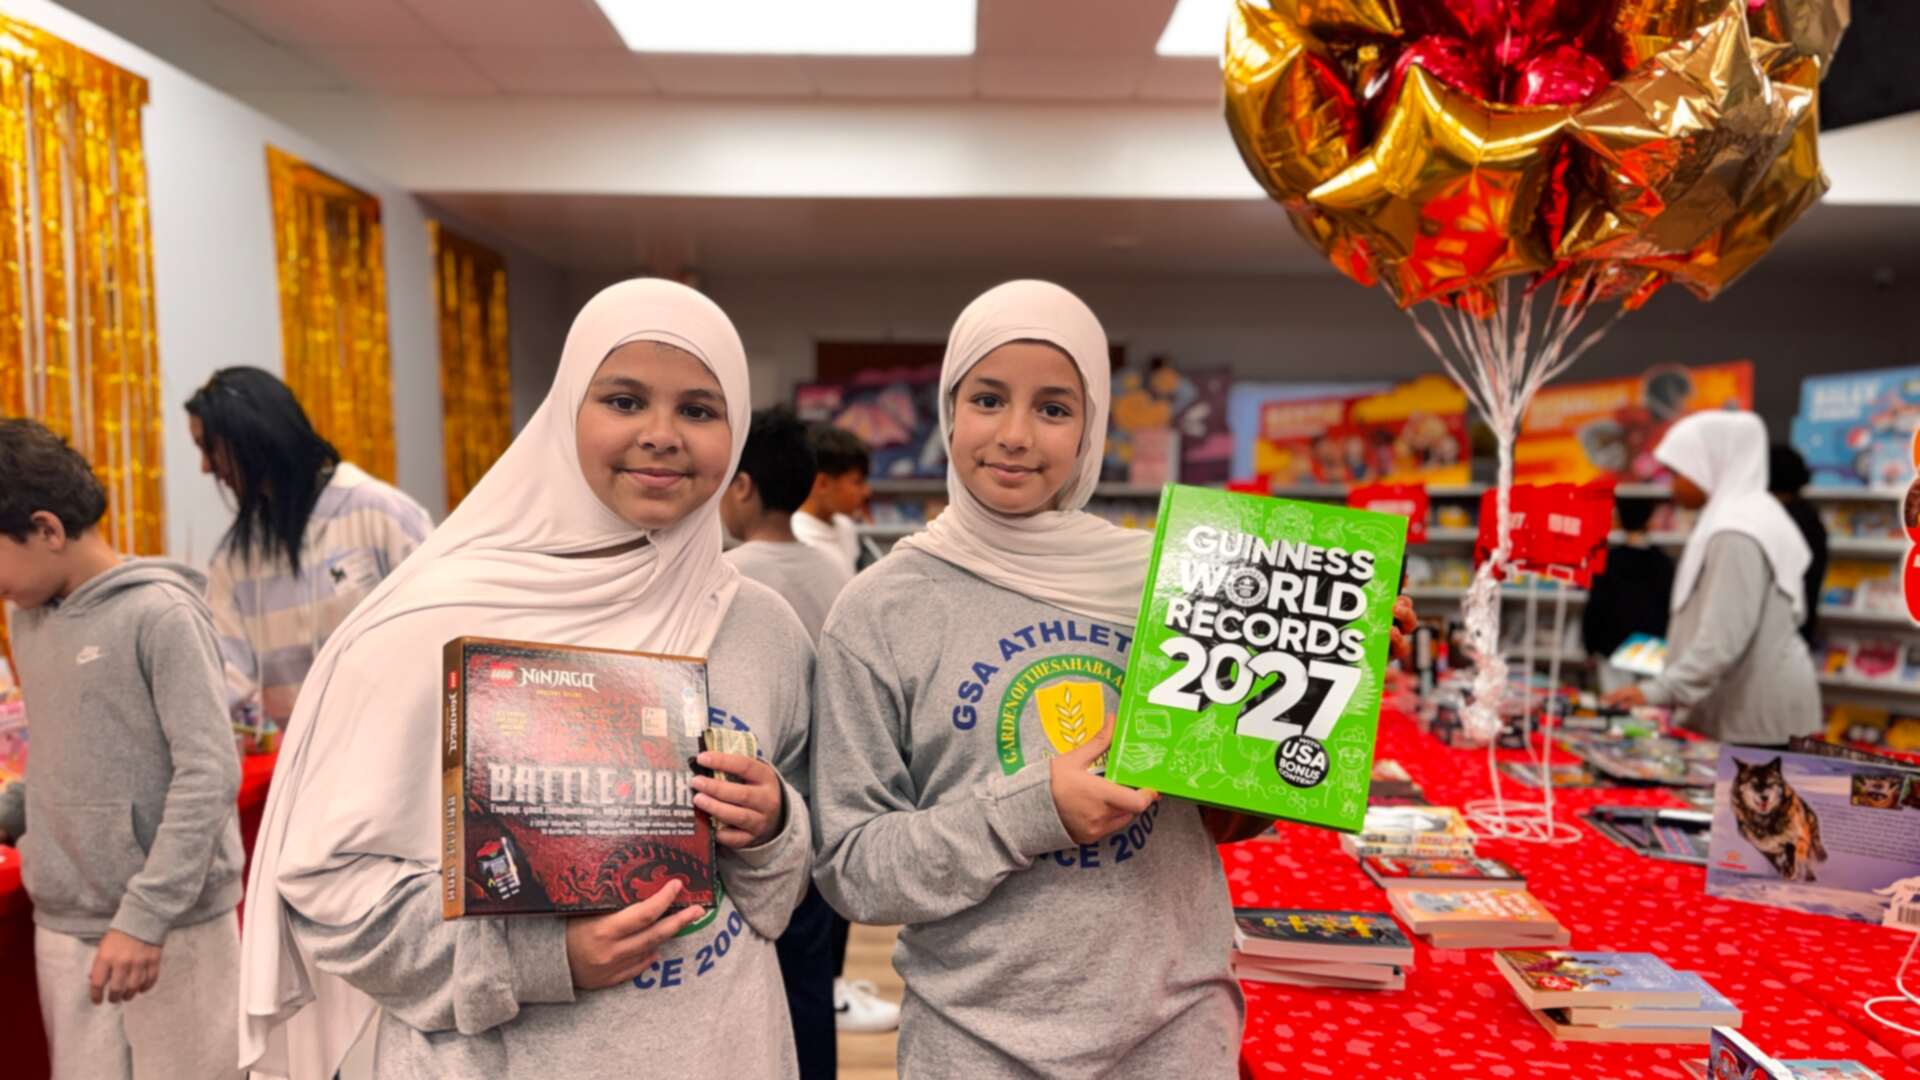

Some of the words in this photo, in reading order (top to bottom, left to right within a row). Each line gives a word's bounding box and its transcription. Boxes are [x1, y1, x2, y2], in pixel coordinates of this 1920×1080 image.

[1188, 525, 1375, 581] GUINNESS
[1179, 559, 1367, 621] WORLD
[1166, 598, 1366, 662] RECORDS
[518, 667, 599, 693] NINJAGO
[953, 661, 999, 730] GSA
[998, 620, 1133, 662] ATHLET
[1147, 636, 1362, 742] 2027
[1001, 699, 1018, 764] GARDEN
[1010, 682, 1029, 701] OF
[488, 763, 617, 804] BATTLE
[1279, 757, 1320, 780] BONUS
[1281, 741, 1326, 772] USA
[695, 911, 743, 976] 200
